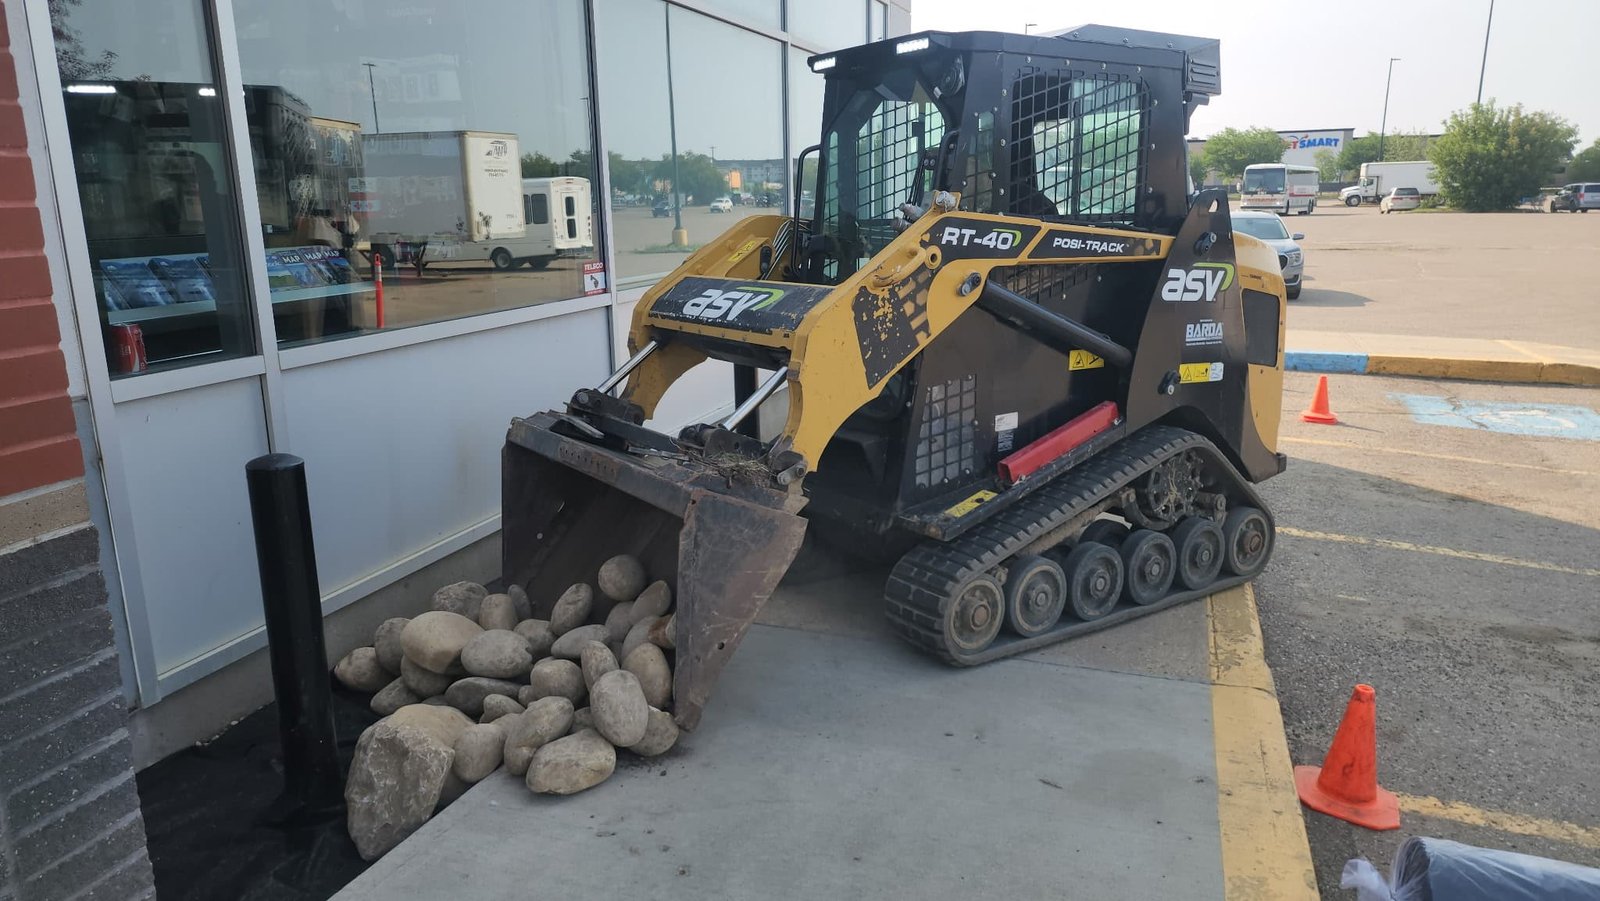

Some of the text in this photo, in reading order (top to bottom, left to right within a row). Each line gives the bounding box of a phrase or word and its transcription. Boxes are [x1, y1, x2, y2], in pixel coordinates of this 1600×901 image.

[941, 226, 1014, 250] RT-40
[1052, 237, 1125, 254] POSI-TRACK
[282, 255, 301, 264] MAP
[304, 252, 322, 260] MAP
[324, 250, 340, 258] MAP
[1185, 322, 1224, 339] BARDA
